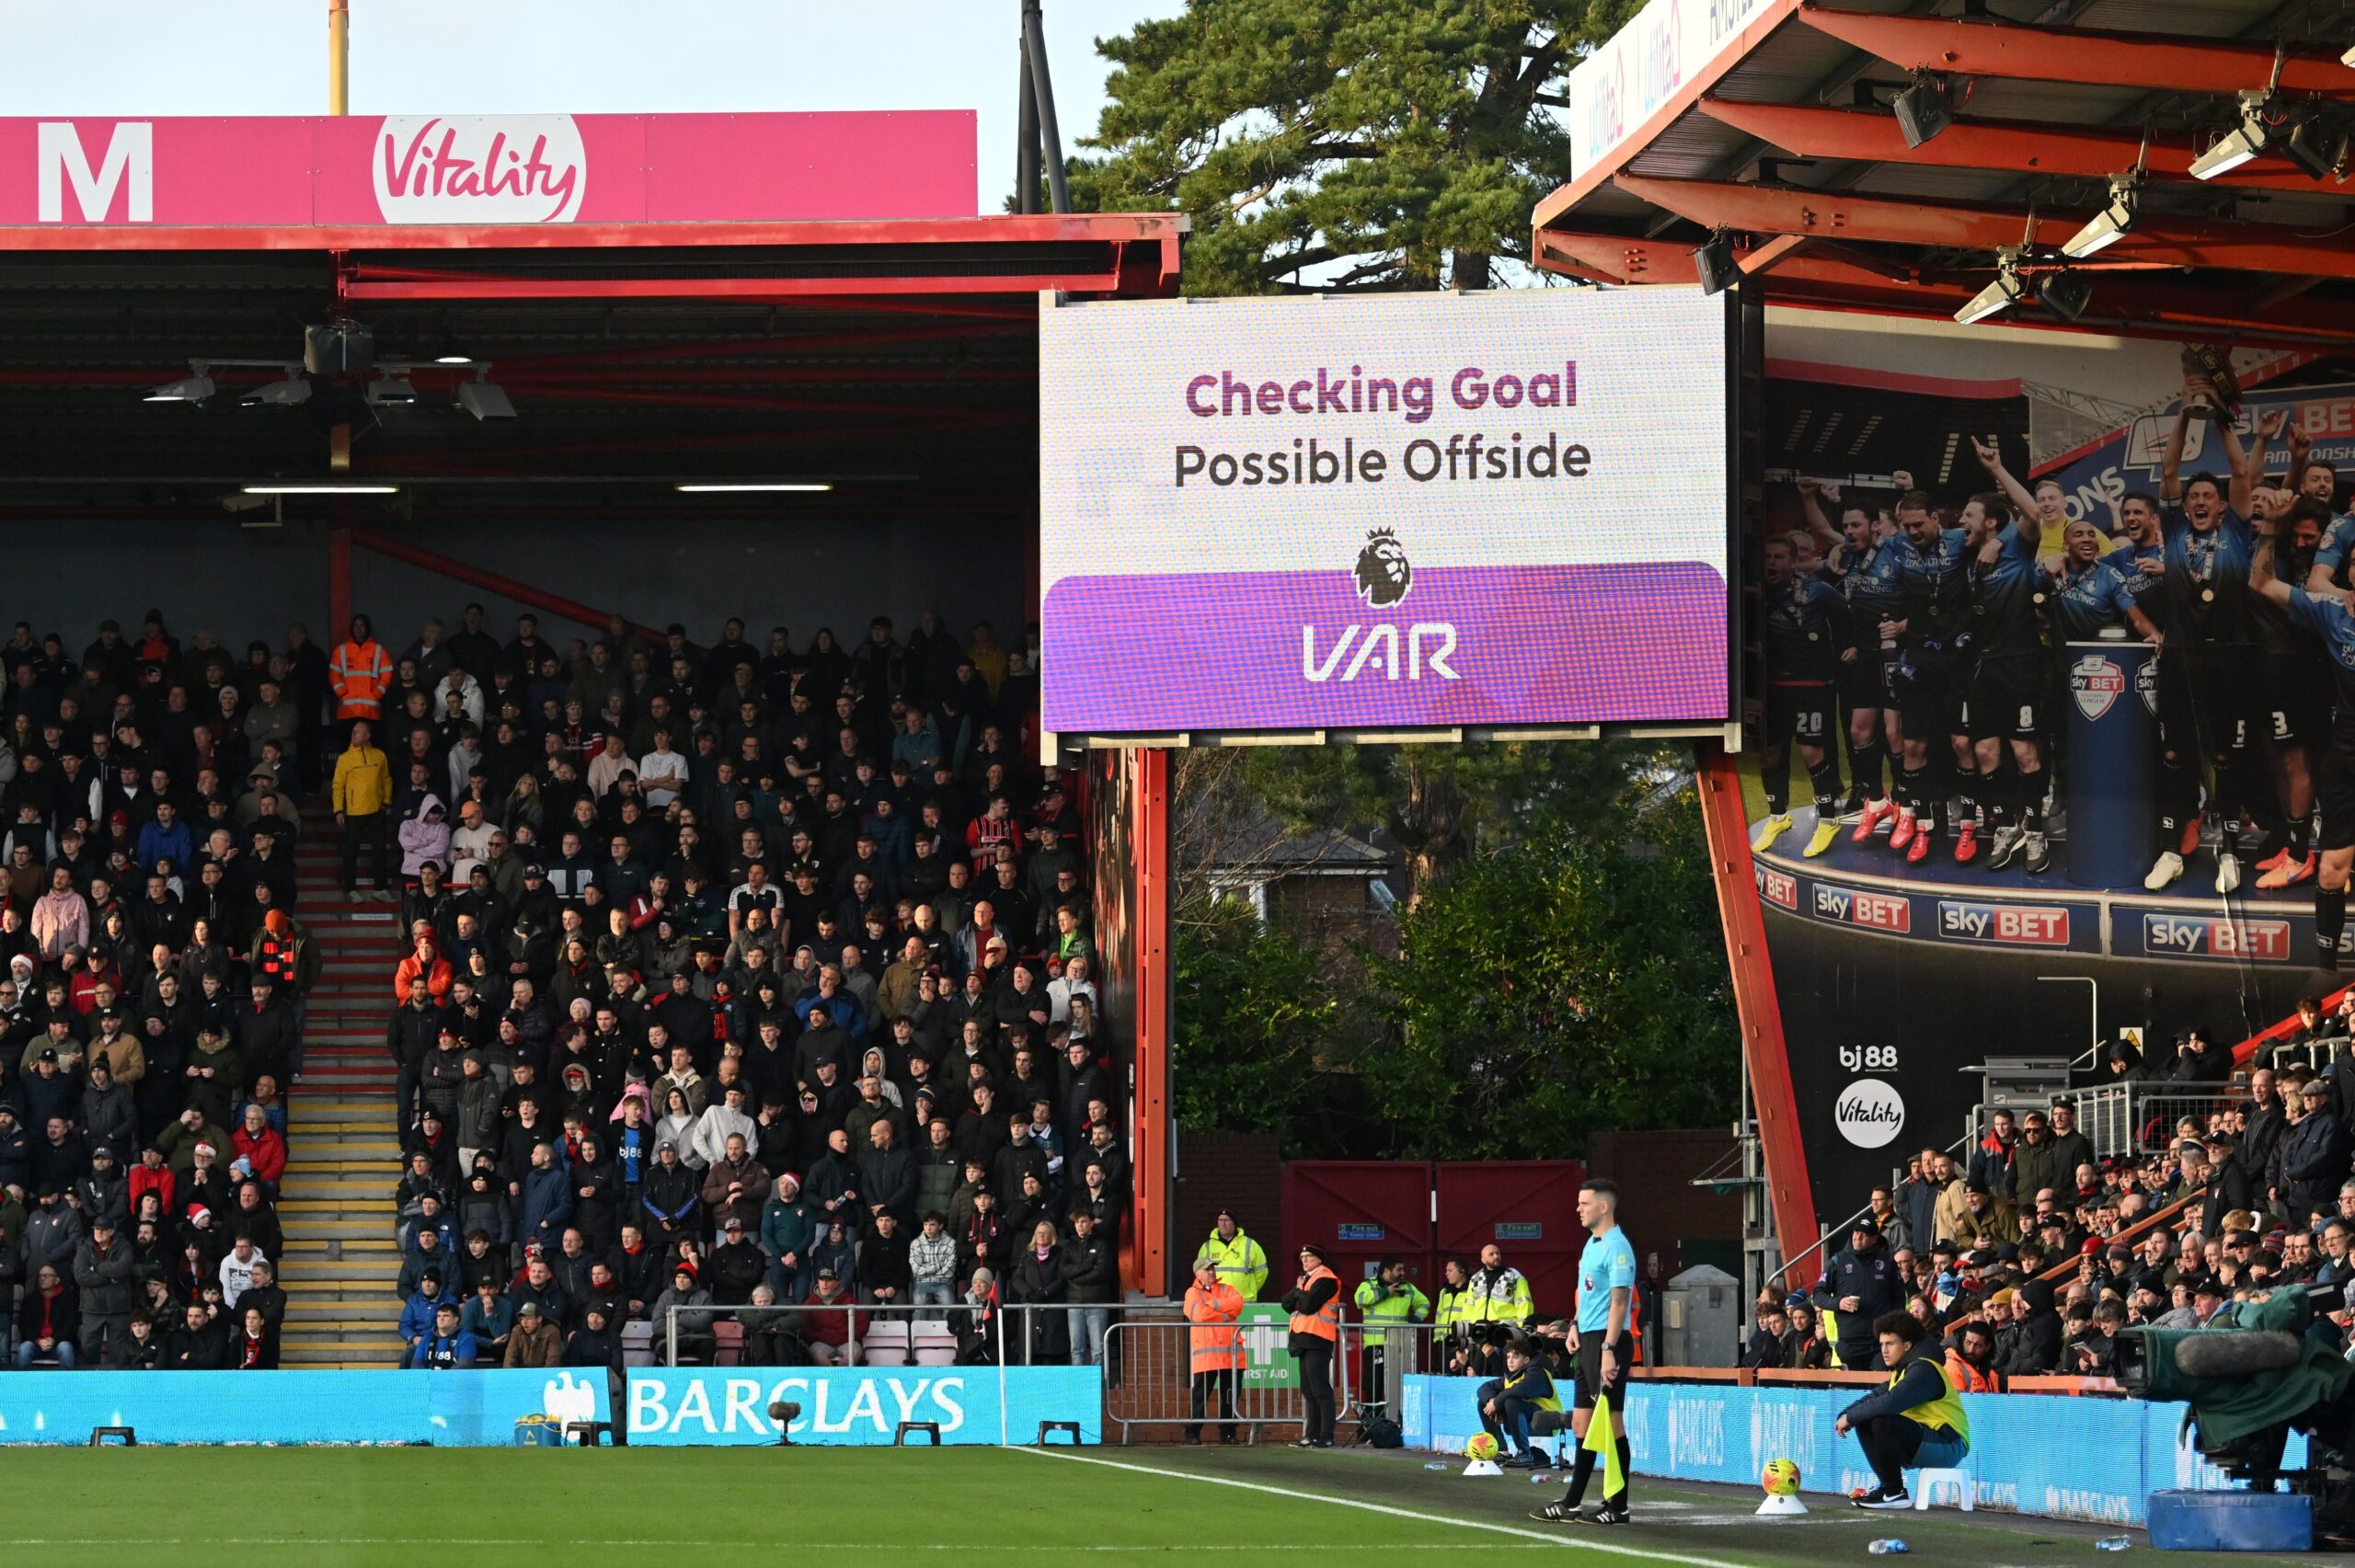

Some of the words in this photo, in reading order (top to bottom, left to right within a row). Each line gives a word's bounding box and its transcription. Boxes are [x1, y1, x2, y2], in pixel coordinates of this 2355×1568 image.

[38, 121, 153, 222] M
[385, 118, 577, 223] Vitality
[1186, 364, 1434, 423] Checking
[1451, 361, 1578, 409] Goal
[2303, 403, 2355, 434] BE
[1176, 438, 1387, 487] Possible
[1403, 432, 1591, 482] Offside
[2064, 465, 2126, 521] ONS
[2061, 589, 2097, 606] SULTING
[1303, 622, 1461, 681] VAR
[2072, 675, 2087, 690] sky
[2091, 677, 2120, 690] BET
[2138, 676, 2155, 690] sky
[1797, 711, 1822, 732] 20
[2019, 704, 2033, 727] 8
[2271, 711, 2288, 735] 3
[1766, 874, 1793, 902] BET
[1818, 889, 1849, 920] sky
[1856, 898, 1903, 926] BET
[1945, 907, 1989, 937] sky
[2000, 913, 2061, 939] BET
[2152, 920, 2202, 952] sky
[2215, 925, 2280, 954] BET
[1840, 1045, 1898, 1072] bj88
[1839, 1095, 1901, 1131] Vitality
[618, 1146, 642, 1159] bj88
[1244, 1368, 1268, 1379] IRST
[1269, 1368, 1288, 1379] AID
[630, 1377, 965, 1435] BARCLAYS
